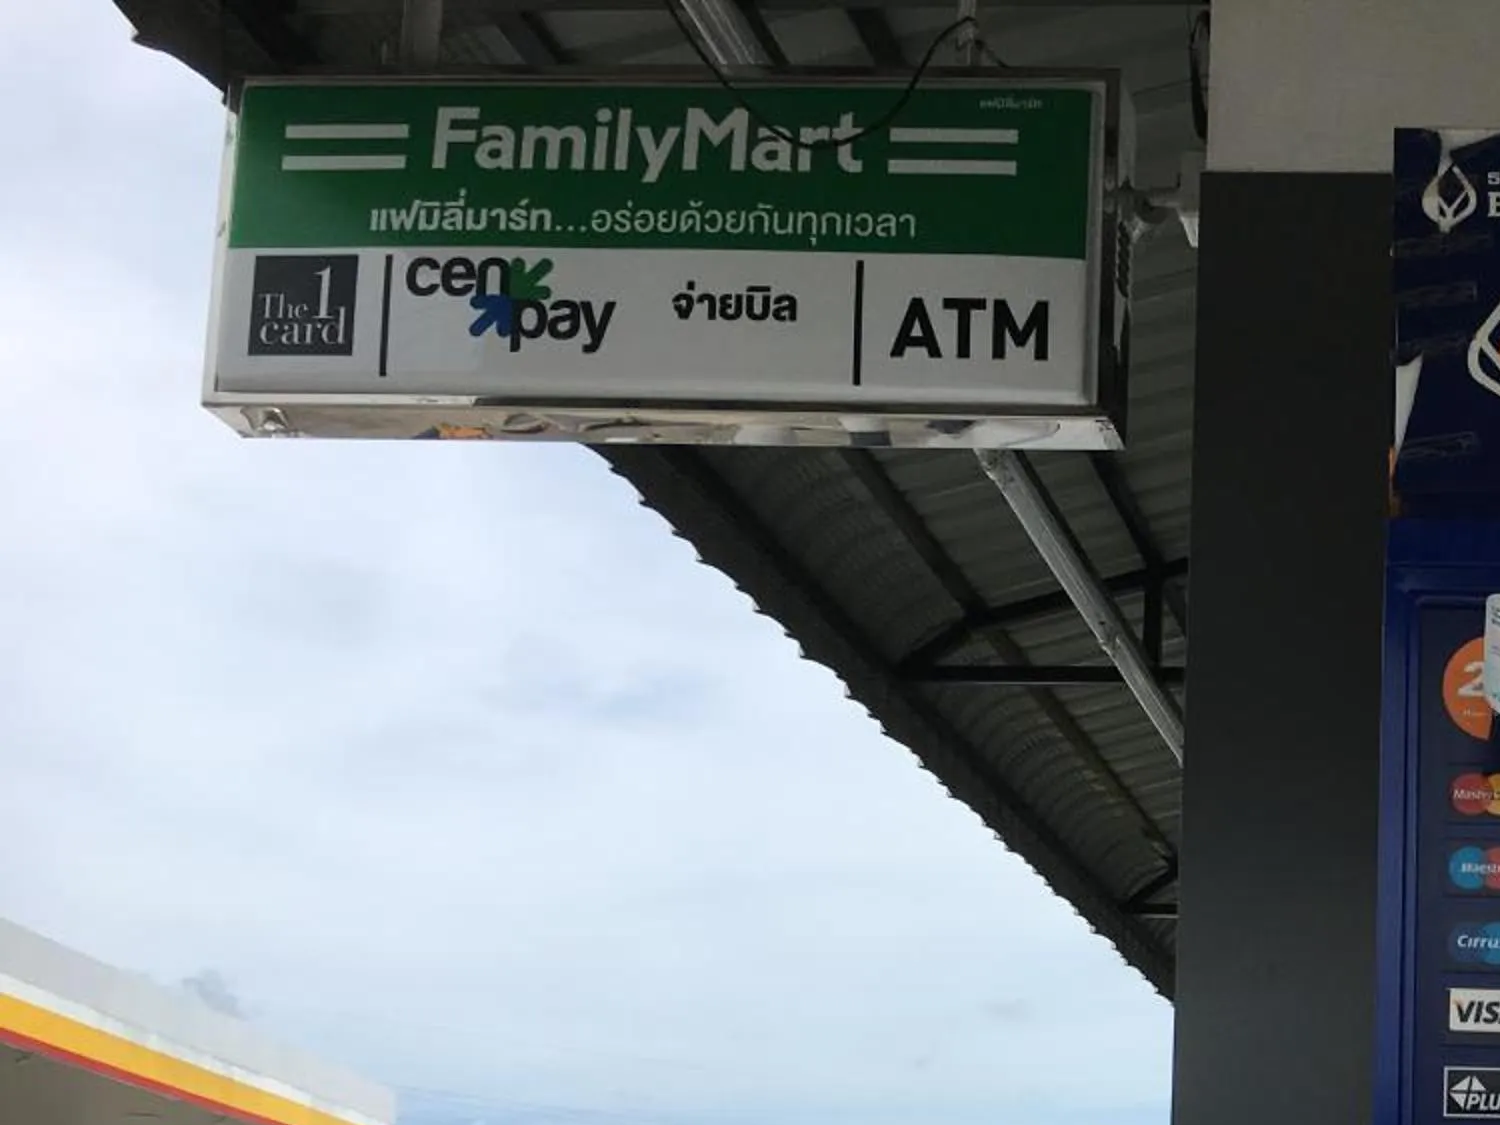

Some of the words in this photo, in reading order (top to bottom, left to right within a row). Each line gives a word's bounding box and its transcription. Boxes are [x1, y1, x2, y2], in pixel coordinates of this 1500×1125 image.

[431, 106, 865, 183] FamilyMart
[257, 292, 310, 319] The
[311, 264, 336, 319] 1
[670, 279, 799, 323] จ่ายบิล
[258, 306, 346, 345] card
[889, 296, 1050, 361] ATM
